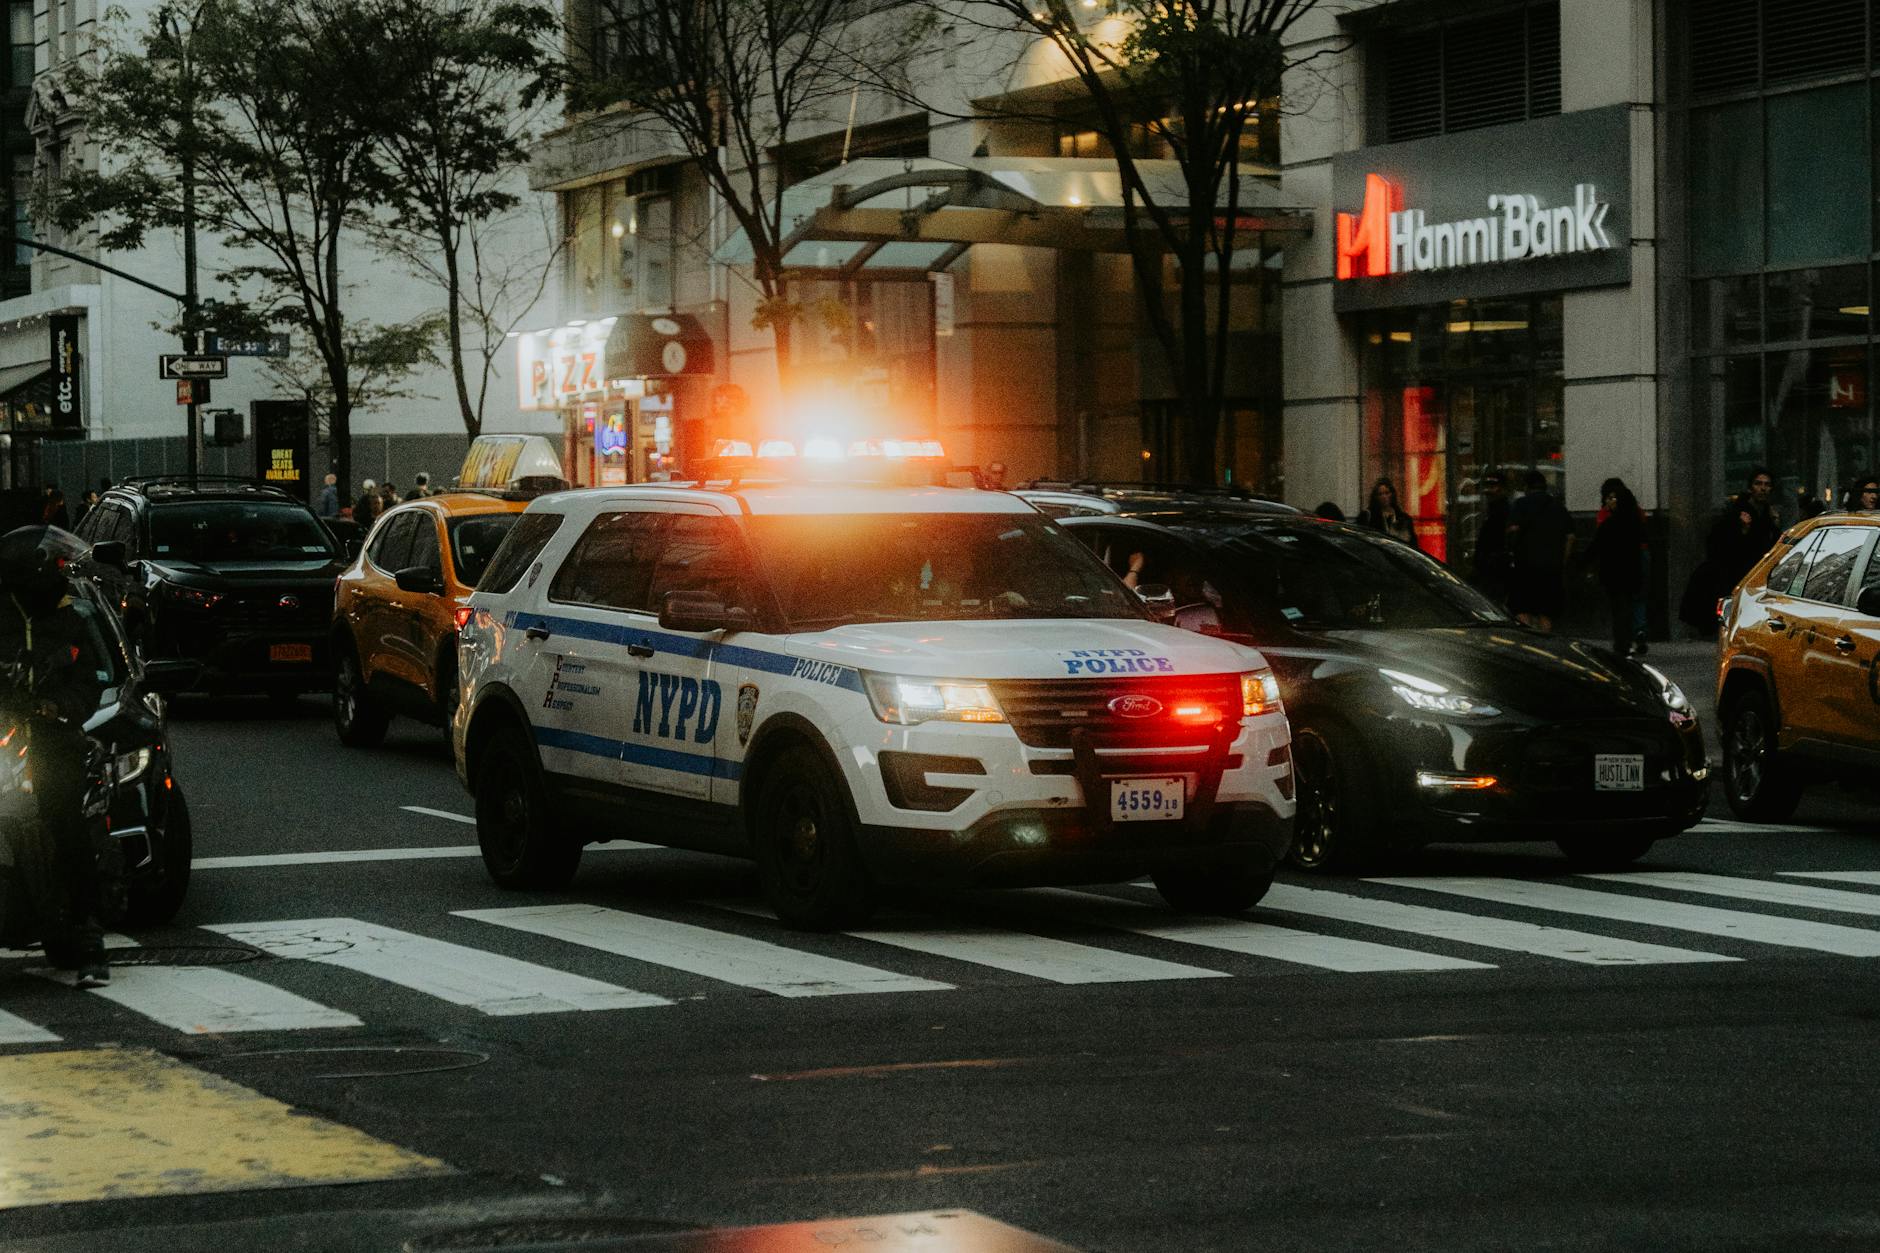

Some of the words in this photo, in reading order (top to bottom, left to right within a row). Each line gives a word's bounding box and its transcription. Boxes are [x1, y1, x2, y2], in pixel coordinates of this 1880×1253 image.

[1391, 194, 1499, 273] Hanmi
[1501, 183, 1610, 260] Bank
[175, 361, 190, 371] ONE
[199, 361, 216, 370] WAY
[531, 352, 608, 398] PIZZ
[57, 377, 72, 414] etc.
[271, 449, 293, 459] GREAT
[271, 459, 293, 469] SEATS
[265, 469, 300, 480] AVAILABLE
[1069, 649, 1146, 657] NYPD
[793, 658, 840, 686] POLICE
[1064, 657, 1175, 674] POLICE
[633, 670, 721, 744] NYPD
[1122, 697, 1151, 712] Ford
[1600, 764, 1640, 782] HUSTLINN
[1118, 790, 1162, 810] 4559
